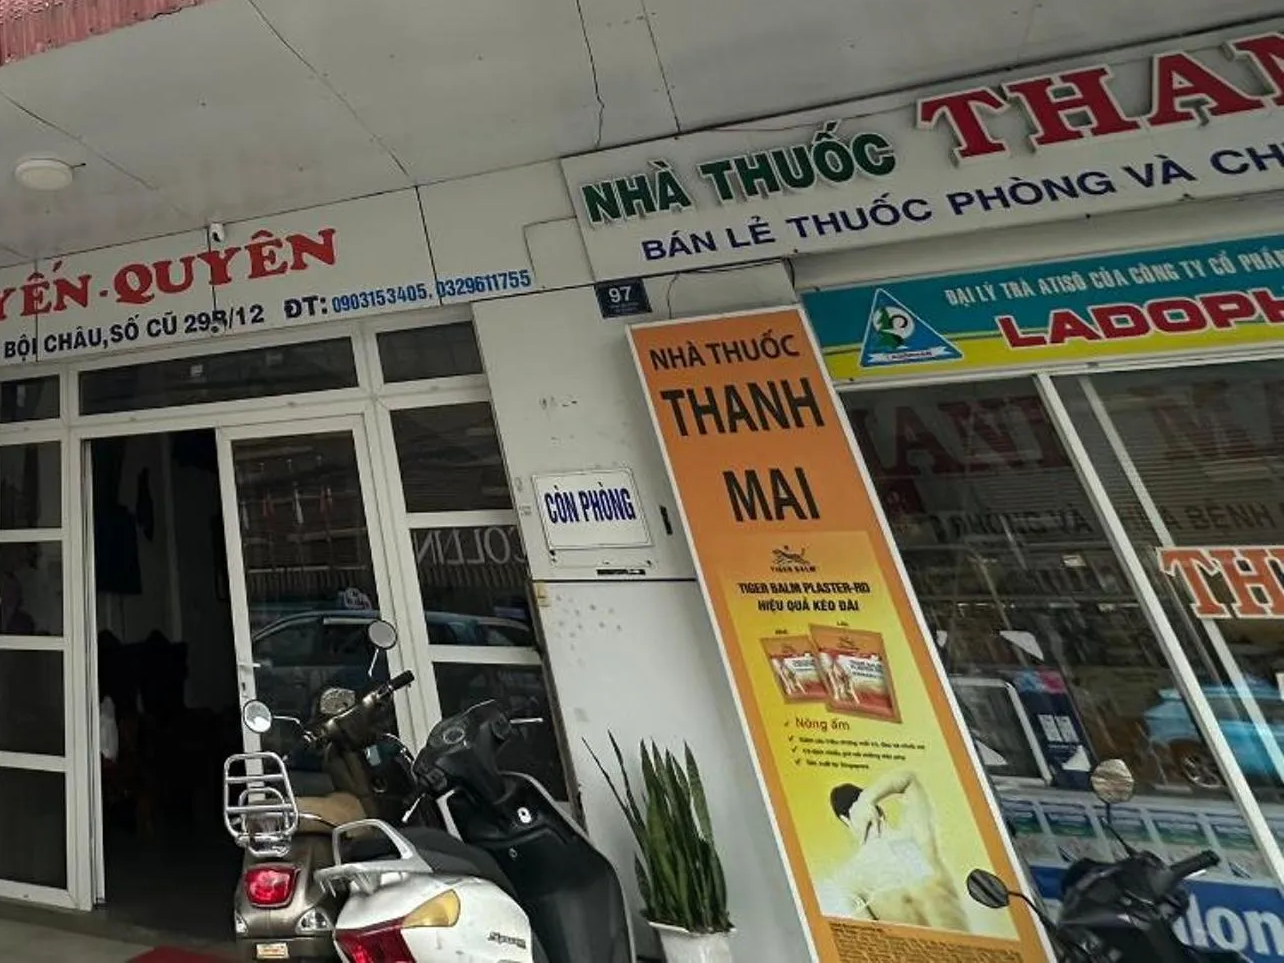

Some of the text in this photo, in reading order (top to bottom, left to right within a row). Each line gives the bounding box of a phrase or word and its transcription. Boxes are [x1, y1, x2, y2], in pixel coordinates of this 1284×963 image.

[580, 158, 693, 225] NHÀ
[697, 120, 898, 203] THUỐC
[641, 229, 718, 262] BÁN
[725, 215, 777, 249] LẺ
[785, 192, 933, 240] THUỐC
[946, 170, 1118, 217] PHÒNG
[1122, 154, 1198, 189] VÀ
[608, 284, 633, 304] 97
[945, 287, 975, 309] ĐẠI
[973, 278, 999, 304] LÝ
[1037, 270, 1089, 297] ATISÔ
[1092, 262, 1129, 291] CỦA
[1133, 254, 1181, 288] CÔNG
[1177, 259, 1207, 279] TY
[4, 333, 38, 363] BỘI
[146, 309, 179, 338] CŨ
[283, 294, 328, 320] ĐT:
[435, 268, 533, 298] 0329611755
[649, 326, 802, 373] NHÀ THUỐC
[660, 377, 827, 438] THANH
[722, 466, 822, 524] MAI
[738, 581, 769, 595] TIGER
[770, 581, 803, 595] BALM
[757, 599, 785, 614] HIỆU
[1156, 545, 1284, 619] TH
